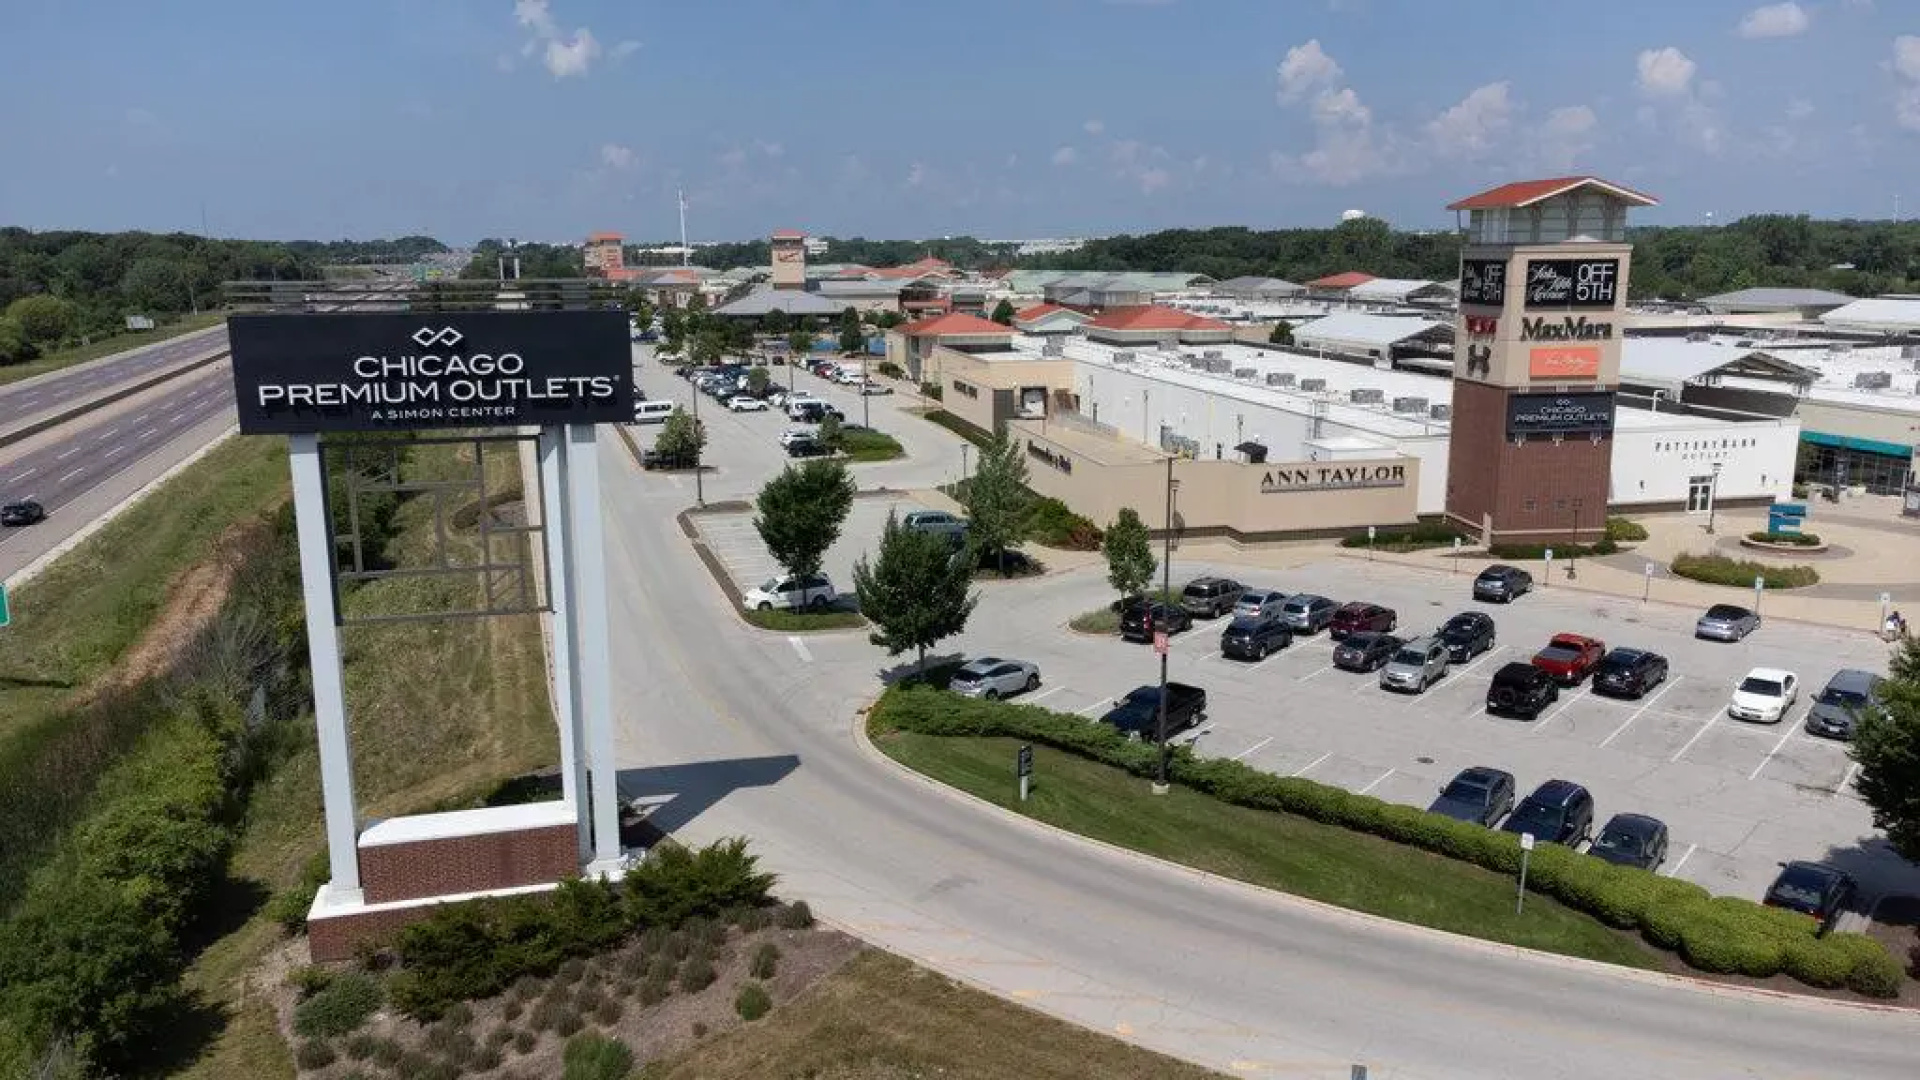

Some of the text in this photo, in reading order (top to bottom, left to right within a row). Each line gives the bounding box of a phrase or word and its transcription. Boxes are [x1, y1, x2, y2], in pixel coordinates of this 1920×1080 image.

[1578, 263, 1614, 282] OFF
[1576, 282, 1613, 301] 5TH
[1520, 316, 1612, 341] MaxMara
[353, 353, 524, 378] CHICAGO
[258, 381, 439, 407] PREMIUM
[372, 406, 515, 420] A SIMON CENTER
[1261, 465, 1404, 486] ANN TAYLOR
